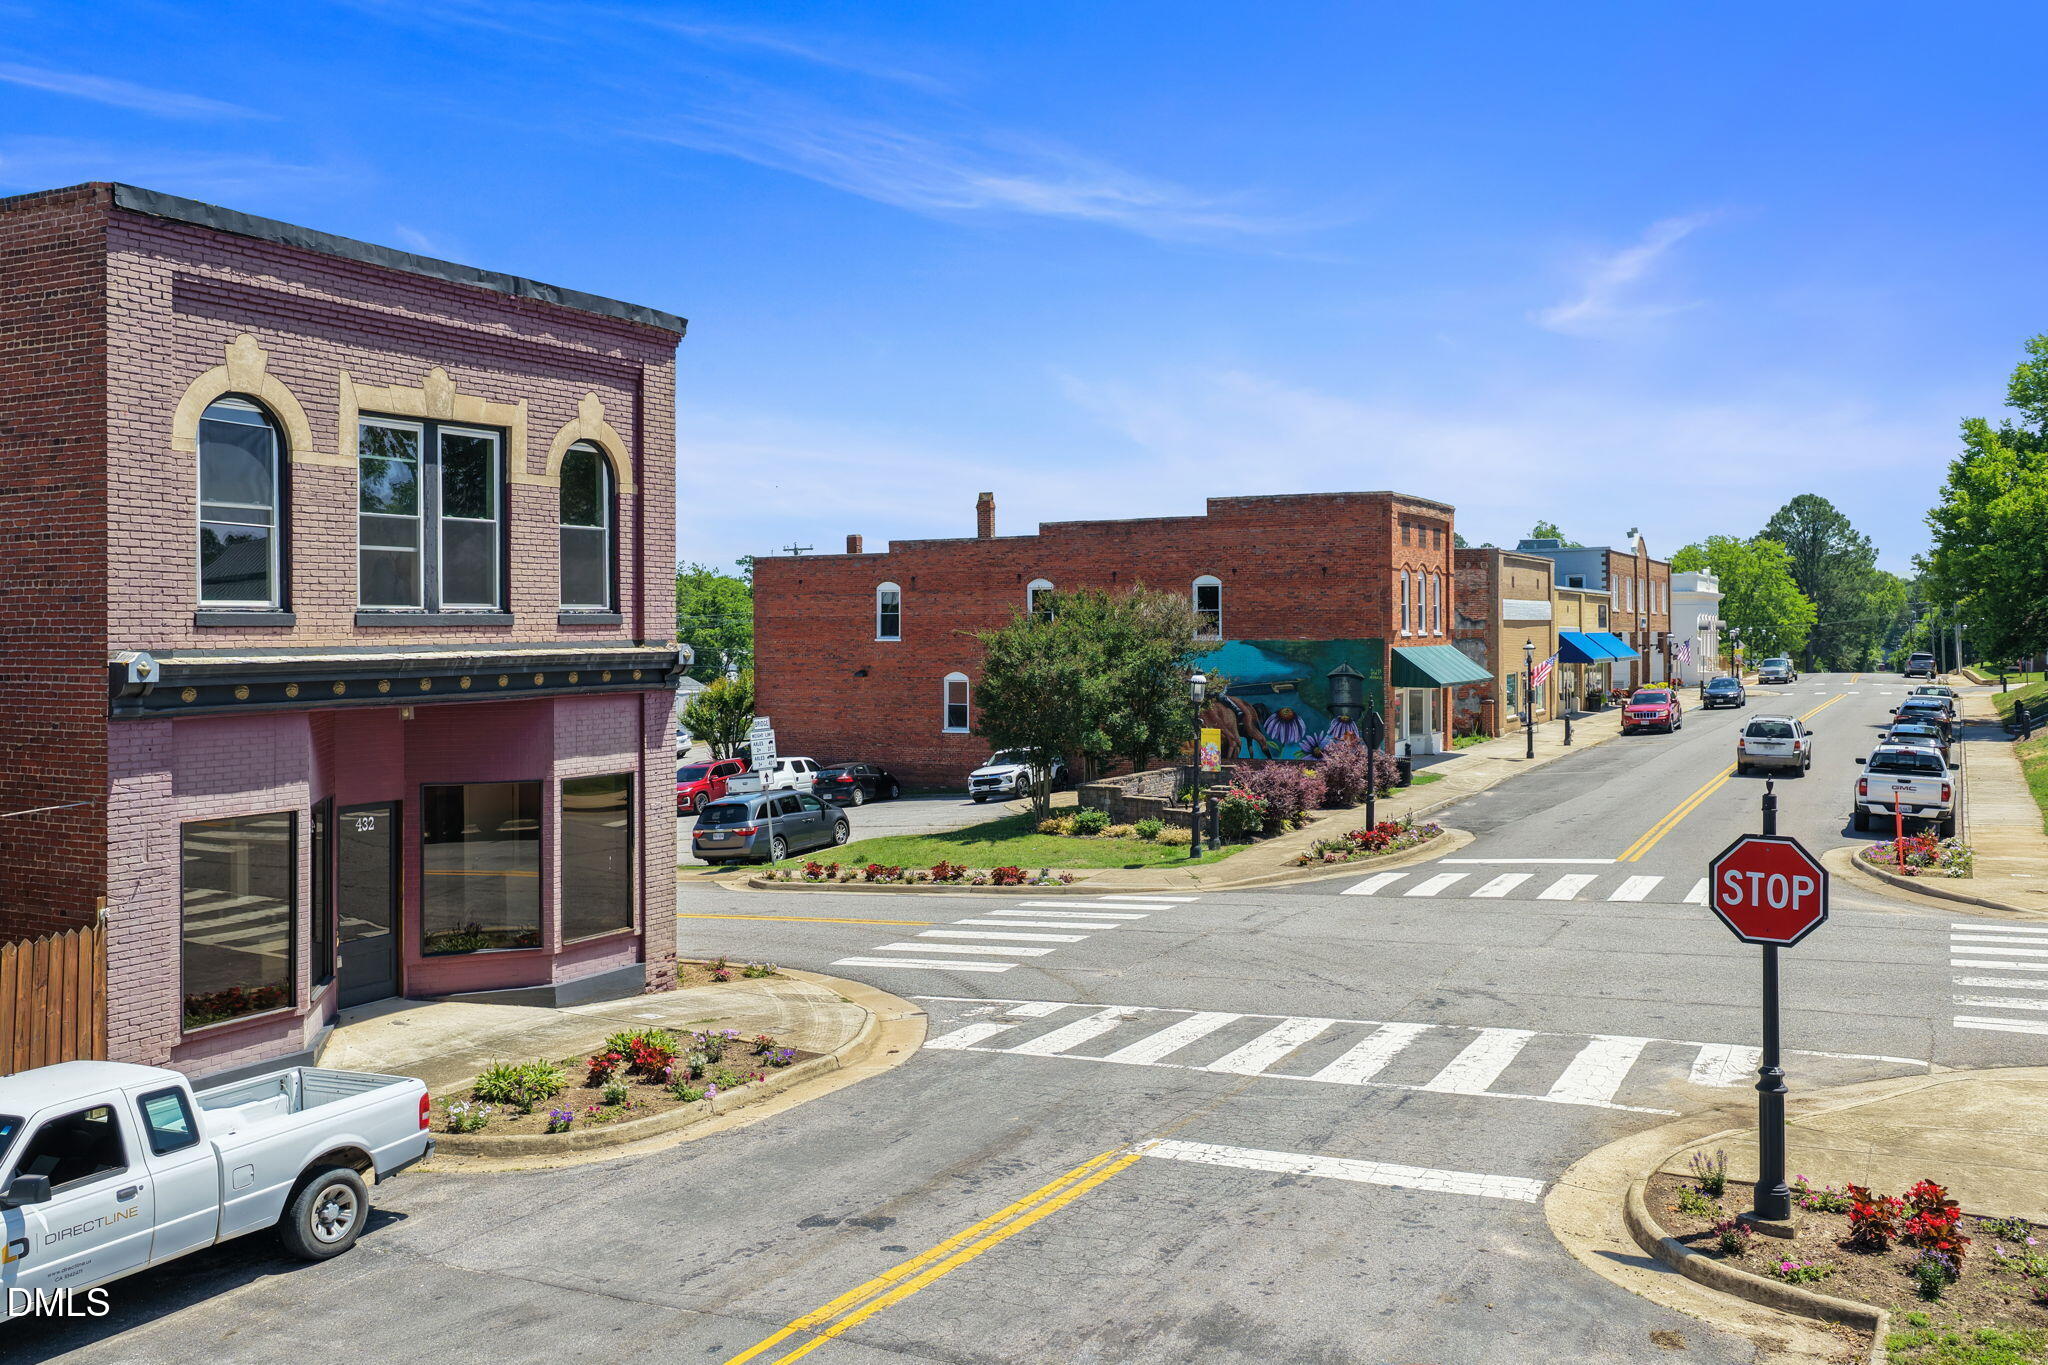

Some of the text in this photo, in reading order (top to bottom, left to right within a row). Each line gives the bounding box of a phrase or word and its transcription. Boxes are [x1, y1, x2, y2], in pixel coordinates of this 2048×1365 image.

[754, 720, 769, 728] BRIDGE
[355, 816, 375, 832] 432
[1722, 869, 1815, 911] STOP
[44, 1205, 139, 1246] DIRECTLINE
